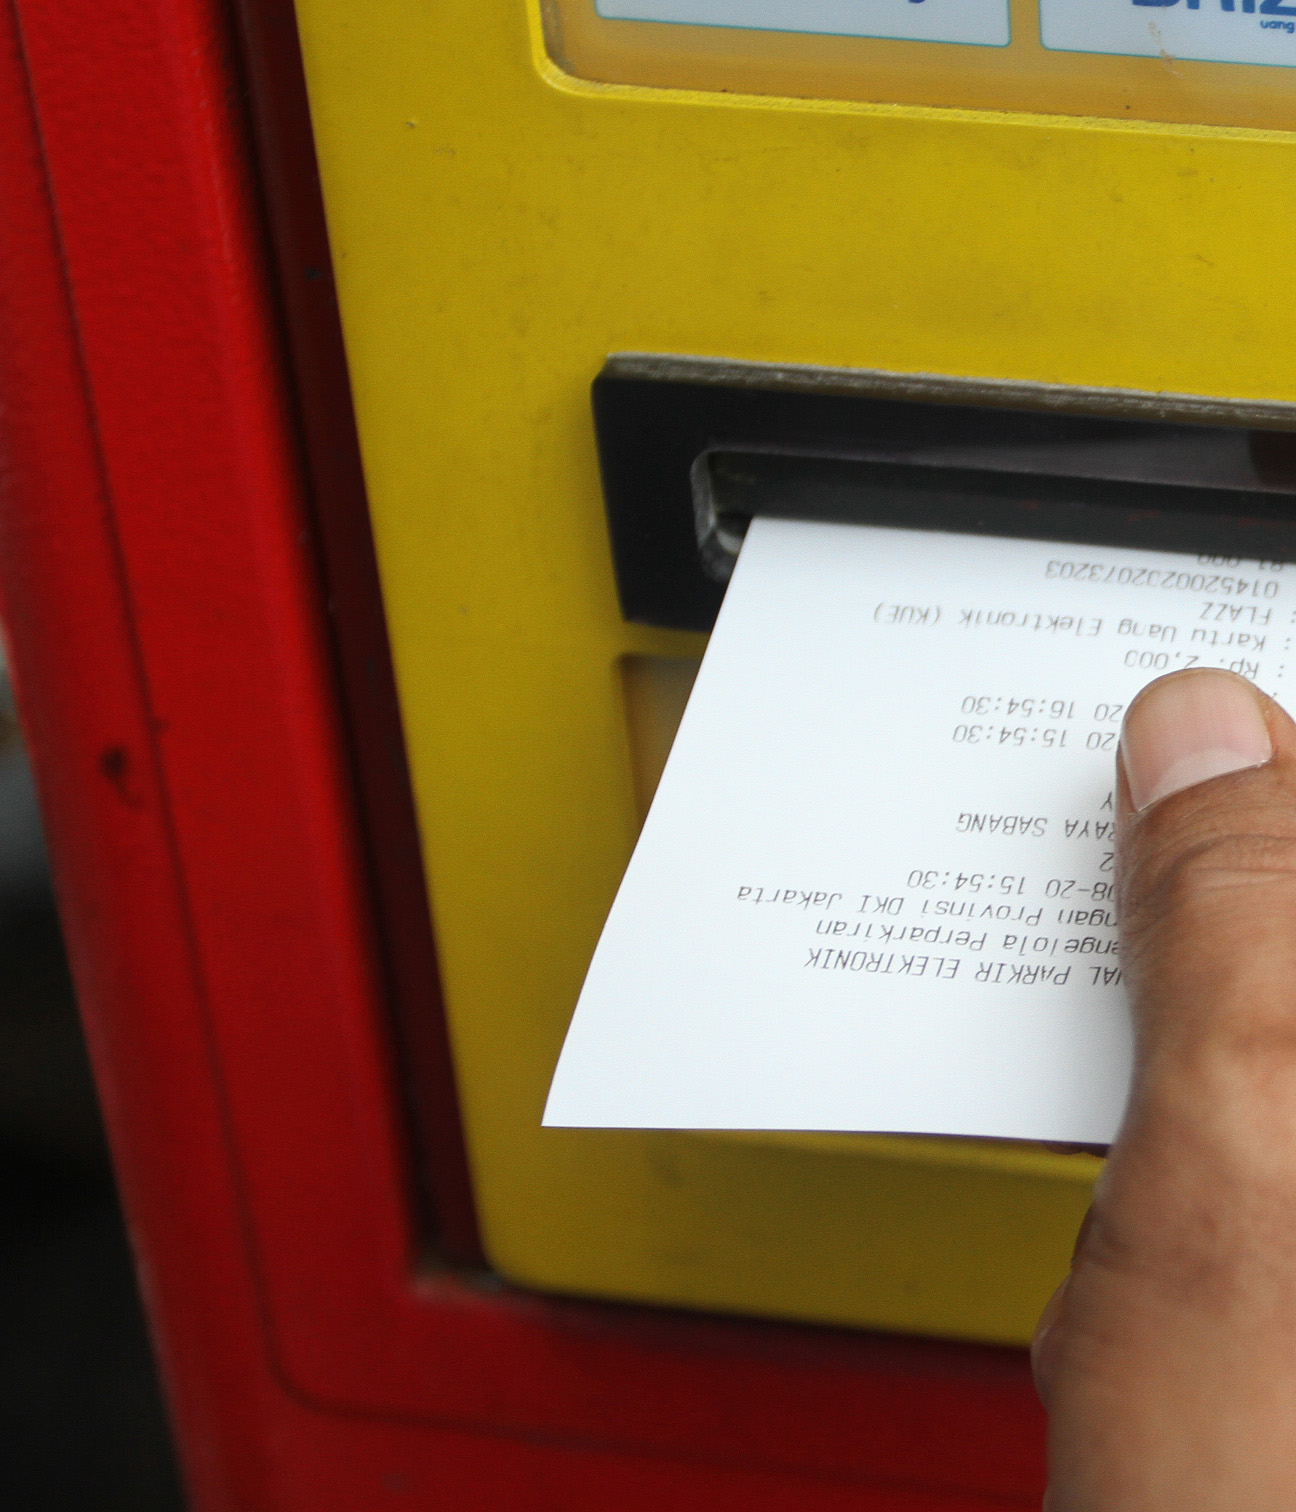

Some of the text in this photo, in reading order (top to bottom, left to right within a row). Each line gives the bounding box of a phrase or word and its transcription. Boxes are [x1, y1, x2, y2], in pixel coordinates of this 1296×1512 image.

[1260, 19, 1295, 34] uang
[874, 602, 940, 627] (KUE)
[958, 609, 1103, 637] Elektronik
[1199, 602, 1272, 626] FLAZZ
[1118, 618, 1177, 644] Uang
[1190, 628, 1266, 652] Kartu
[961, 696, 1076, 720] 16:54:30
[952, 724, 1068, 748] 15:54:30
[956, 812, 1048, 838] SABANG
[906, 870, 1026, 895] 15:54:30
[736, 886, 842, 910] Jakarta
[856, 895, 904, 916] DKI
[920, 899, 1043, 926] Provinsi
[816, 920, 988, 951] Perparkiran
[803, 948, 960, 979] ELEKTRONIK
[974, 962, 1071, 986] PARKIR
